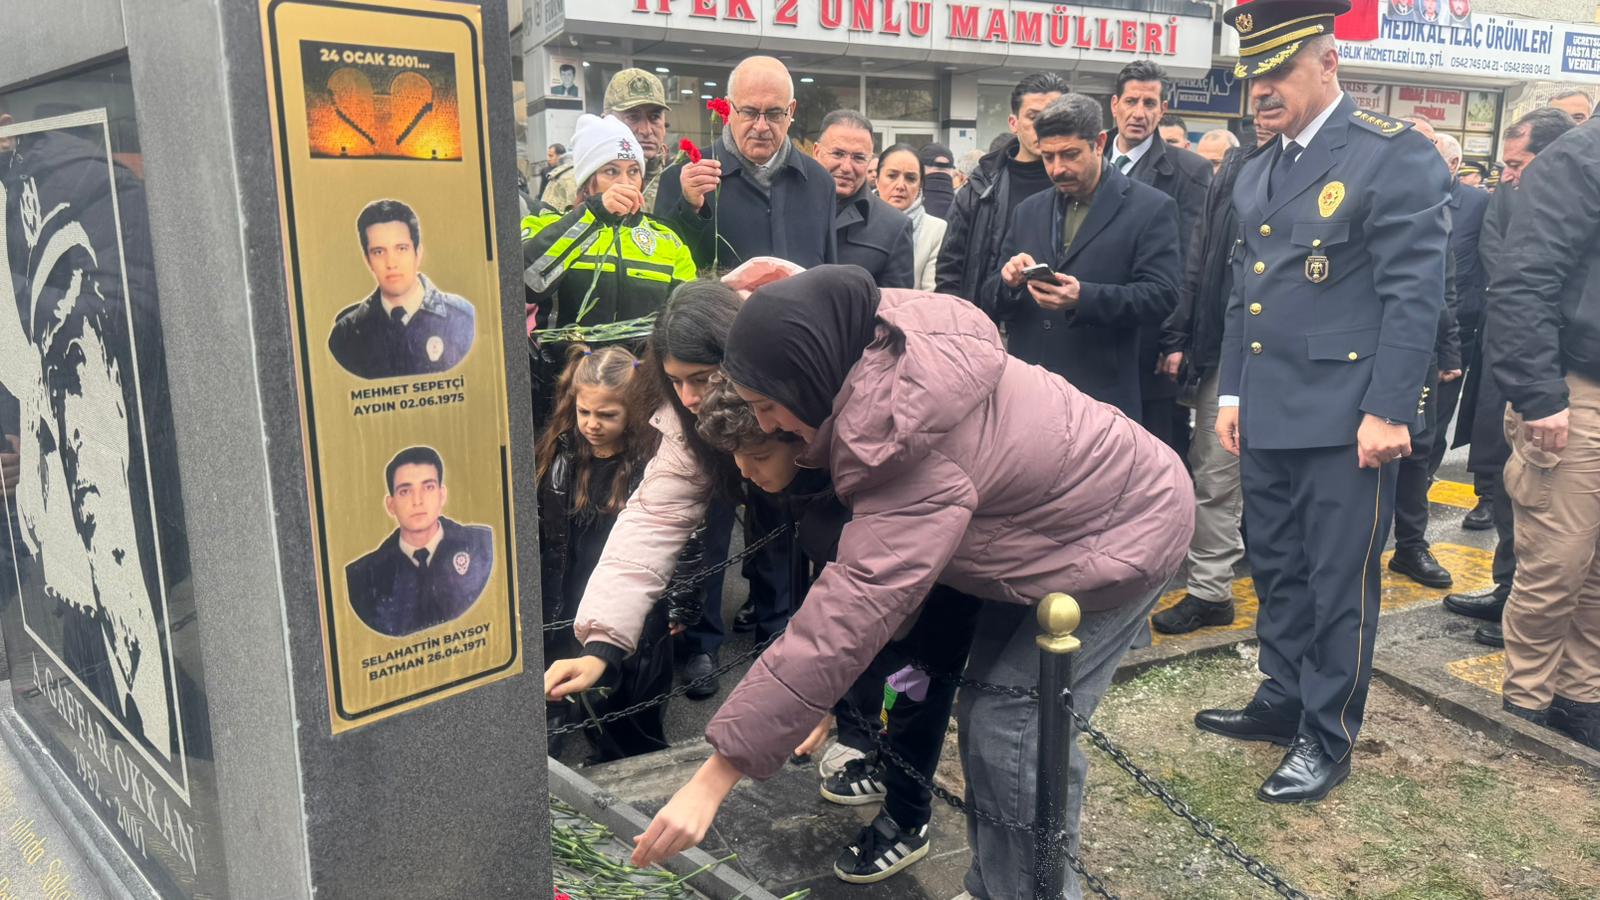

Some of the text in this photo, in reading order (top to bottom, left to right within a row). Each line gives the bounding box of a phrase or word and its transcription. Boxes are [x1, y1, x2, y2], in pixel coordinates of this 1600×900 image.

[948, 3, 1178, 56] MAMÜLLERİ
[1486, 17, 1554, 55] ÜRÜNLERİ
[320, 48, 430, 69] 24 OCAK 2001...
[1363, 43, 1411, 64] HİZMETLERİ
[1411, 48, 1428, 66] LTD.
[1450, 56, 1468, 69] 0542
[1504, 61, 1520, 73] 0542
[1566, 45, 1590, 58] HASTA
[351, 374, 465, 401] MEHMET SEPETÇİ
[353, 392, 465, 416] AYDIN 02.06.1975
[361, 622, 490, 669] SELAHATTİN BAYSOY
[369, 637, 487, 681] BATMAN 26.04.1971
[73, 746, 102, 802] 1952
[114, 796, 148, 860] 2001
[113, 744, 198, 876] OKKAN
